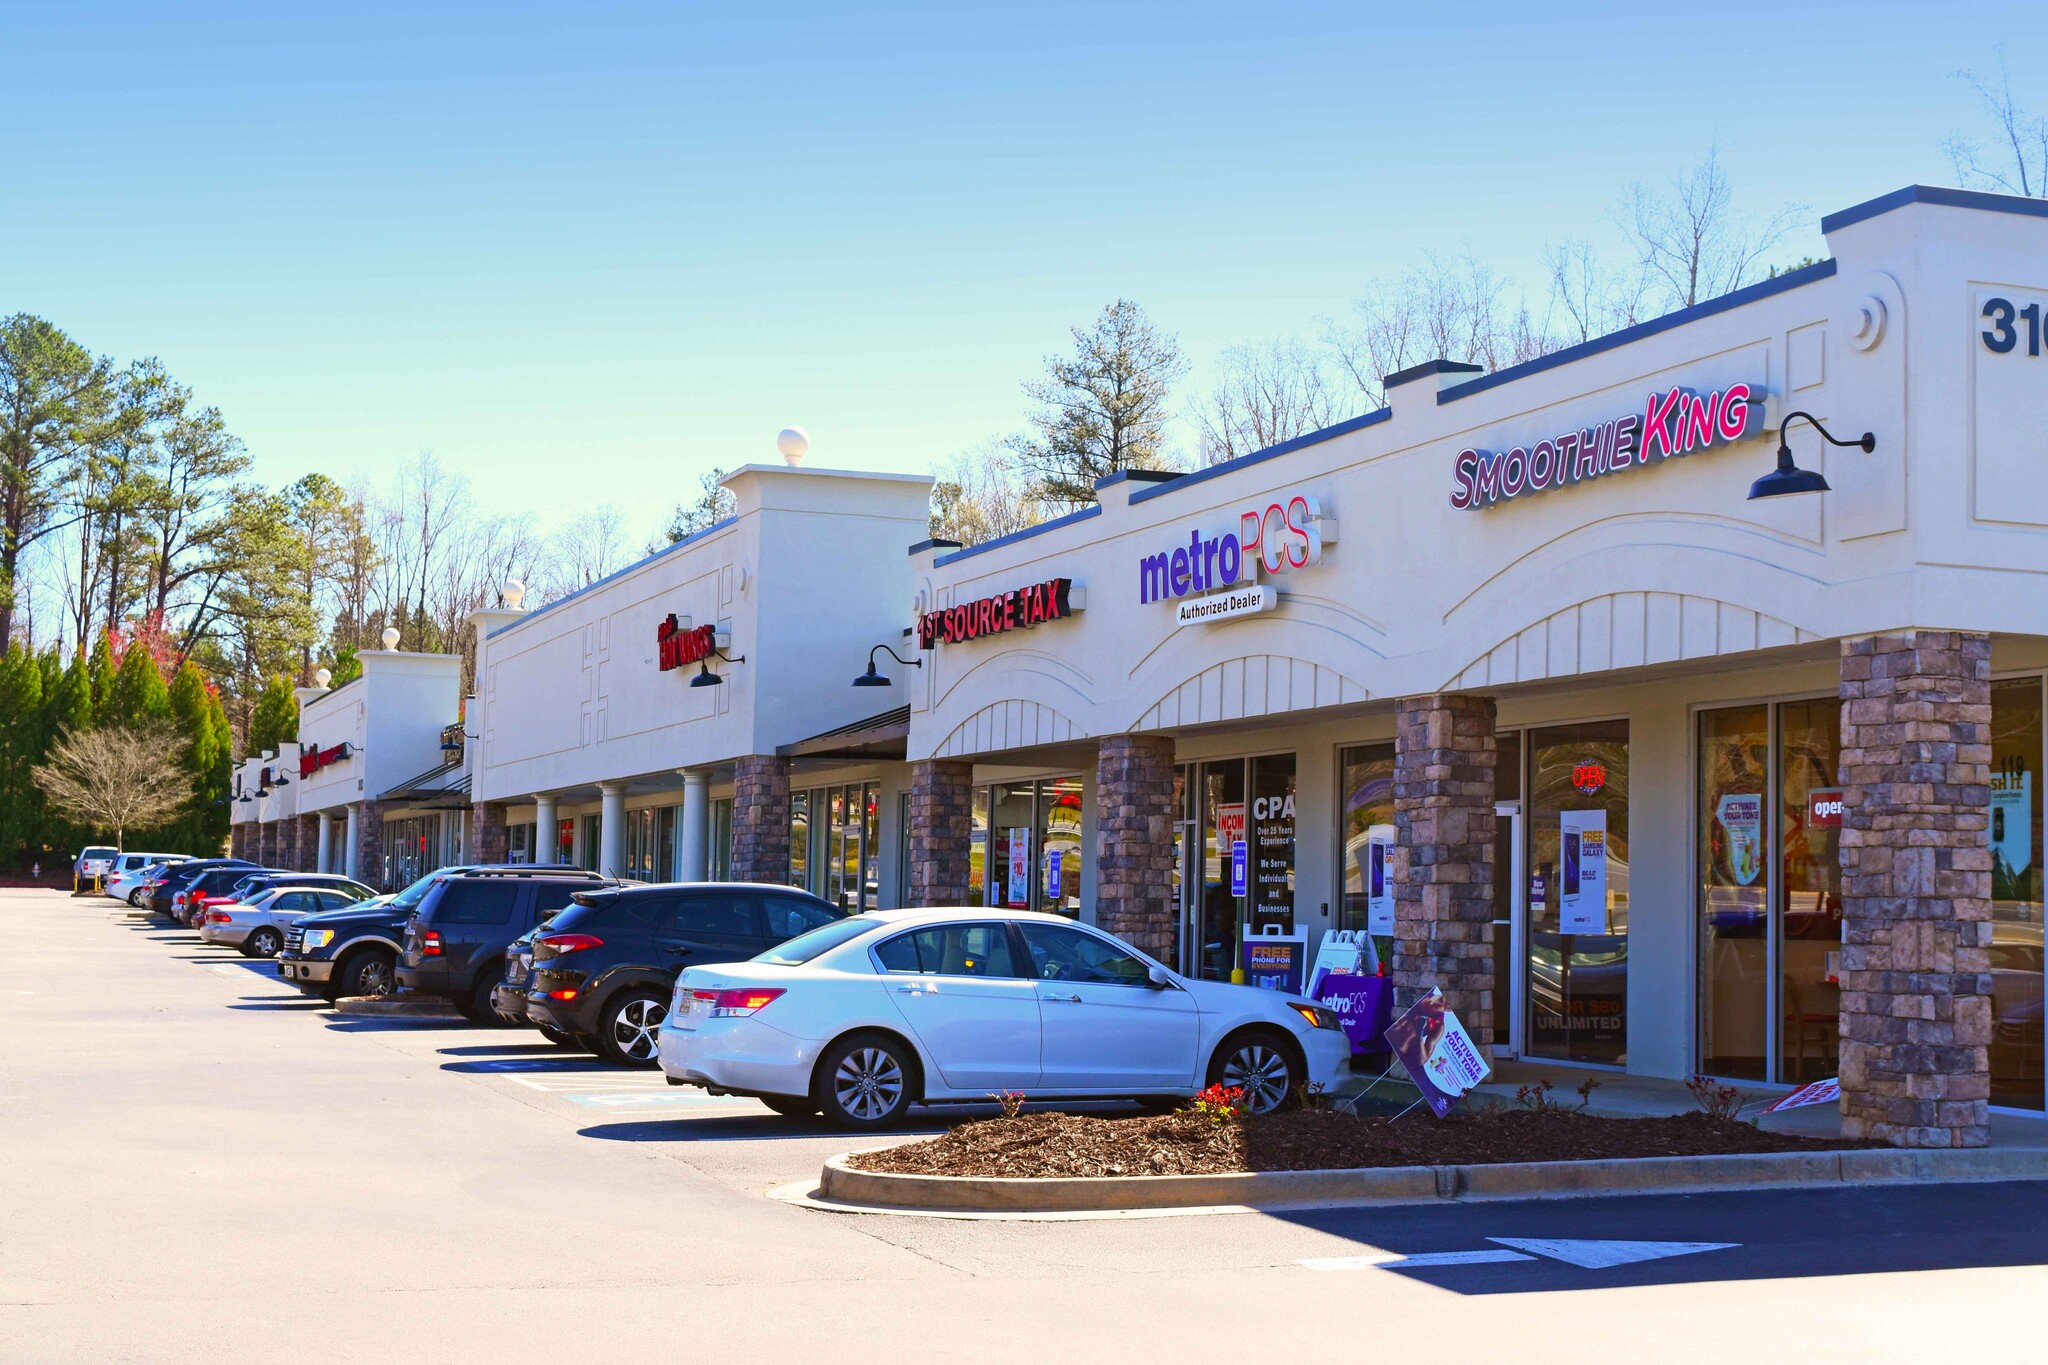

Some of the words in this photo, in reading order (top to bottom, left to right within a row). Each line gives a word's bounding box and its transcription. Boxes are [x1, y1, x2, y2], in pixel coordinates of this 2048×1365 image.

[1982, 298, 2048, 356] 31
[1449, 414, 1637, 510] SMOOTHIE
[1140, 496, 1314, 604] metroPCS
[918, 610, 940, 650] 1ST
[943, 591, 1015, 644] SOURCE
[1020, 577, 1064, 625] TAX
[1180, 597, 1228, 621] Authorized
[1230, 592, 1261, 611] Dealer
[2001, 754, 2024, 778] 119
[1573, 766, 1605, 787] OPEN
[1253, 795, 1296, 820] CPA
[1726, 802, 1757, 811] ACTIVATE
[1218, 812, 1244, 831] INCOM
[1724, 811, 1741, 820] YOUR
[1742, 811, 1759, 820] TONE
[1257, 827, 1269, 836] Over
[1270, 826, 1277, 835] 25
[1278, 826, 1293, 834] Years
[1582, 830, 1604, 842] FREE
[1260, 837, 1289, 846] Experience
[1582, 848, 1604, 857] GALAXY
[1260, 859, 1269, 868] We
[1270, 859, 1287, 868] Serve
[1259, 874, 1289, 883] Individuals
[1268, 889, 1280, 898] and
[1258, 904, 1290, 913] Businesses
[1252, 946, 1291, 958] FREE
[1537, 1016, 1621, 1030] UNLIMITED
[1445, 1031, 1463, 1058] YOUR
[1461, 1056, 1480, 1083] TONE
[1451, 1030, 1483, 1075] ACTIVATE
